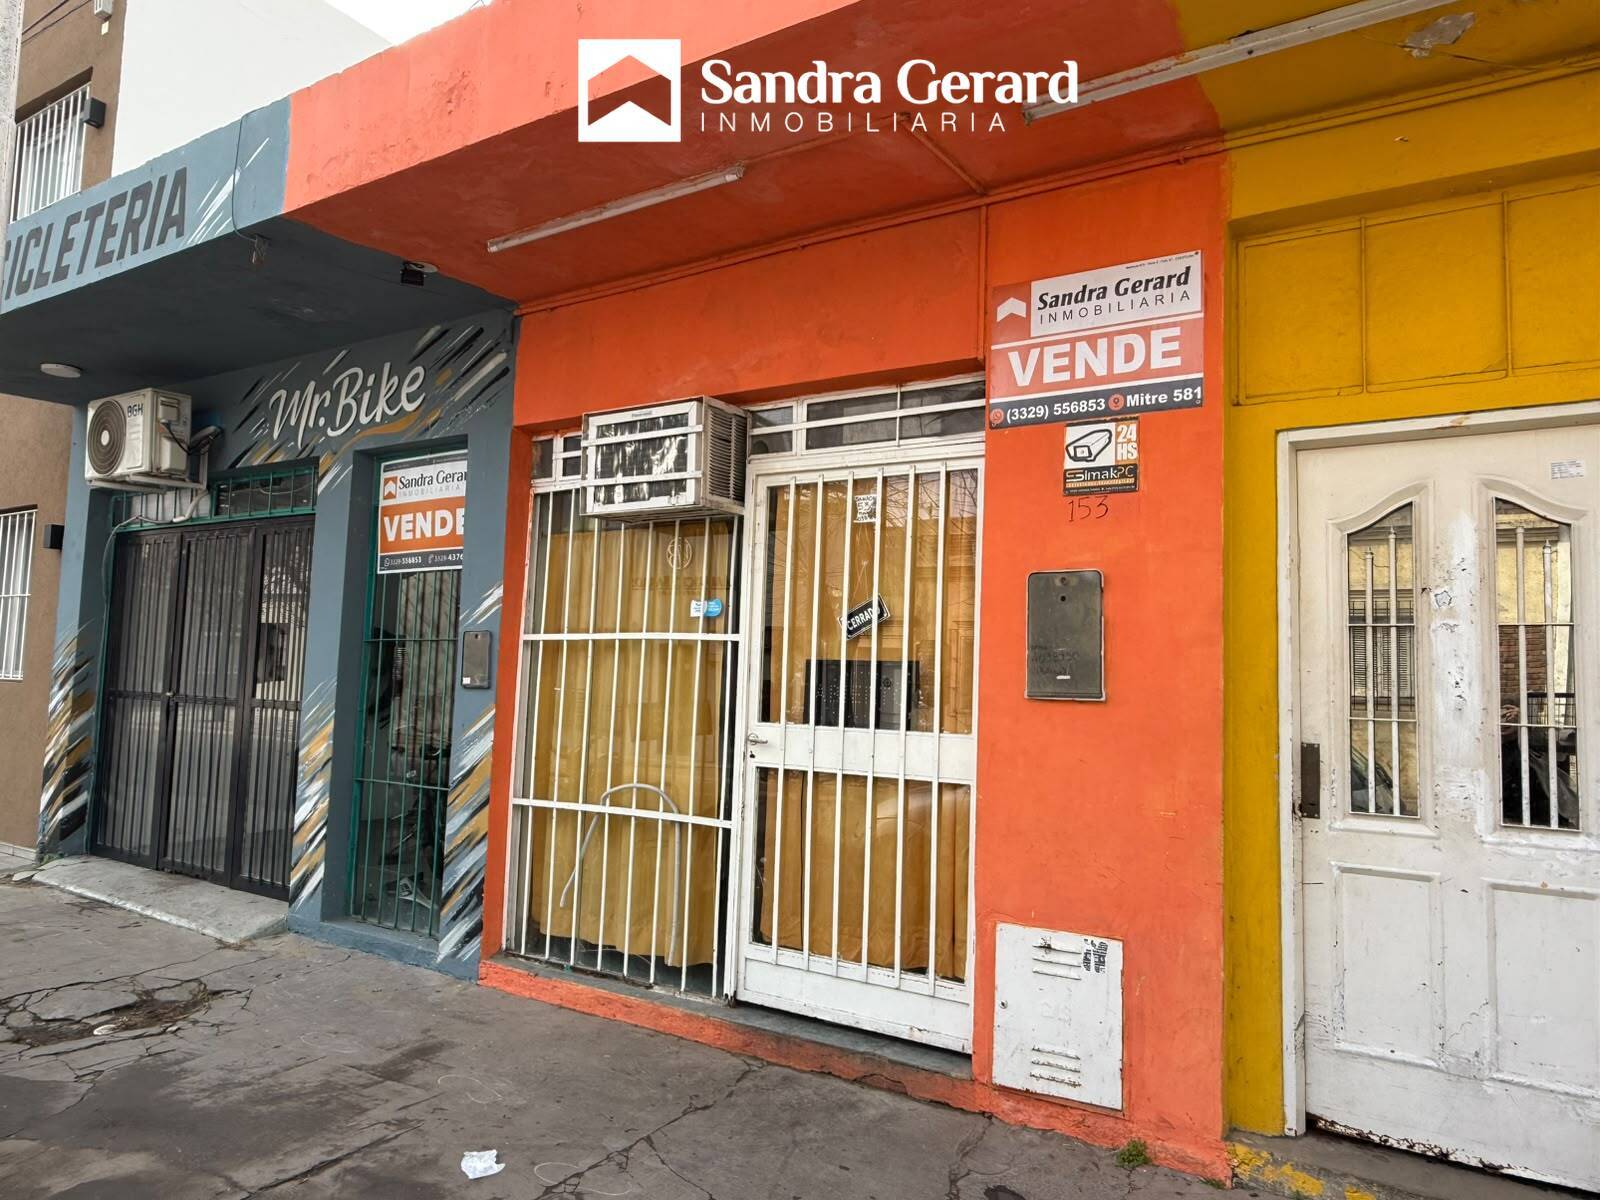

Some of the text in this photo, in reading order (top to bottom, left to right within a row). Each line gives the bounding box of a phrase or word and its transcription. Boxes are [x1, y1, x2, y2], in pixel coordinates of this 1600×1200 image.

[1037, 265, 1192, 311] Sandra Gerard
[1039, 290, 1191, 325] INMOBILIARIA
[1007, 326, 1182, 388] VENDE
[127, 403, 144, 418] BGH
[1006, 386, 1202, 424] (3329) 556853 Mitre 581
[1117, 423, 1137, 443] 24
[1117, 442, 1138, 460] HS
[399, 473, 433, 490] Sandra
[1068, 495, 1109, 523] 153
[383, 507, 465, 542] VENDE
[847, 606, 881, 631] CERRAD
